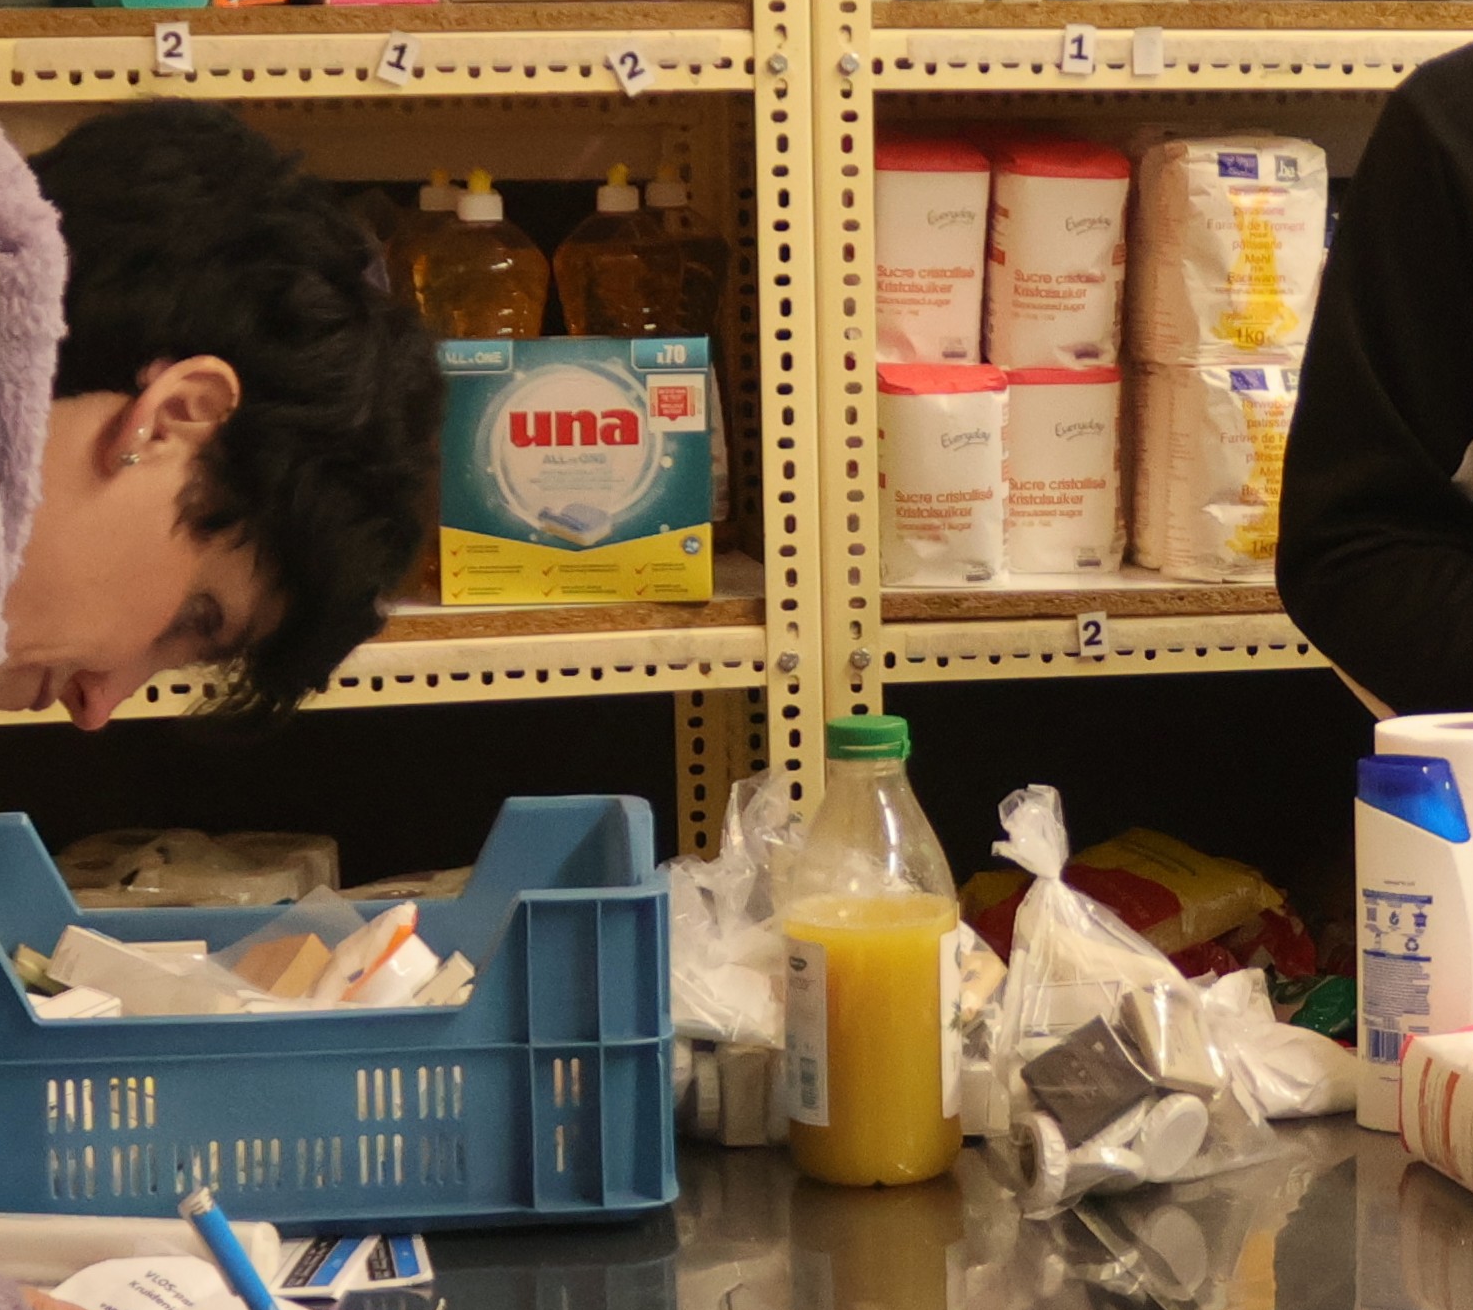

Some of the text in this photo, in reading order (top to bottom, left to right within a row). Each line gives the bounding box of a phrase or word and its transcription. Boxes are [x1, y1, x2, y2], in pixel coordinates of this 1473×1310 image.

[162, 31, 183, 58] 2
[387, 43, 407, 71] 1
[1069, 34, 1089, 61] 1
[619, 51, 645, 80] 2
[877, 265, 915, 279] Sucre
[1014, 269, 1052, 284] Sucre
[509, 408, 640, 448] una
[895, 486, 994, 504] Sucre cristallisé
[1008, 475, 1107, 491] Sucre cristallisé
[1008, 492, 1084, 506] Kristalsuiker
[1082, 620, 1103, 647] 2
